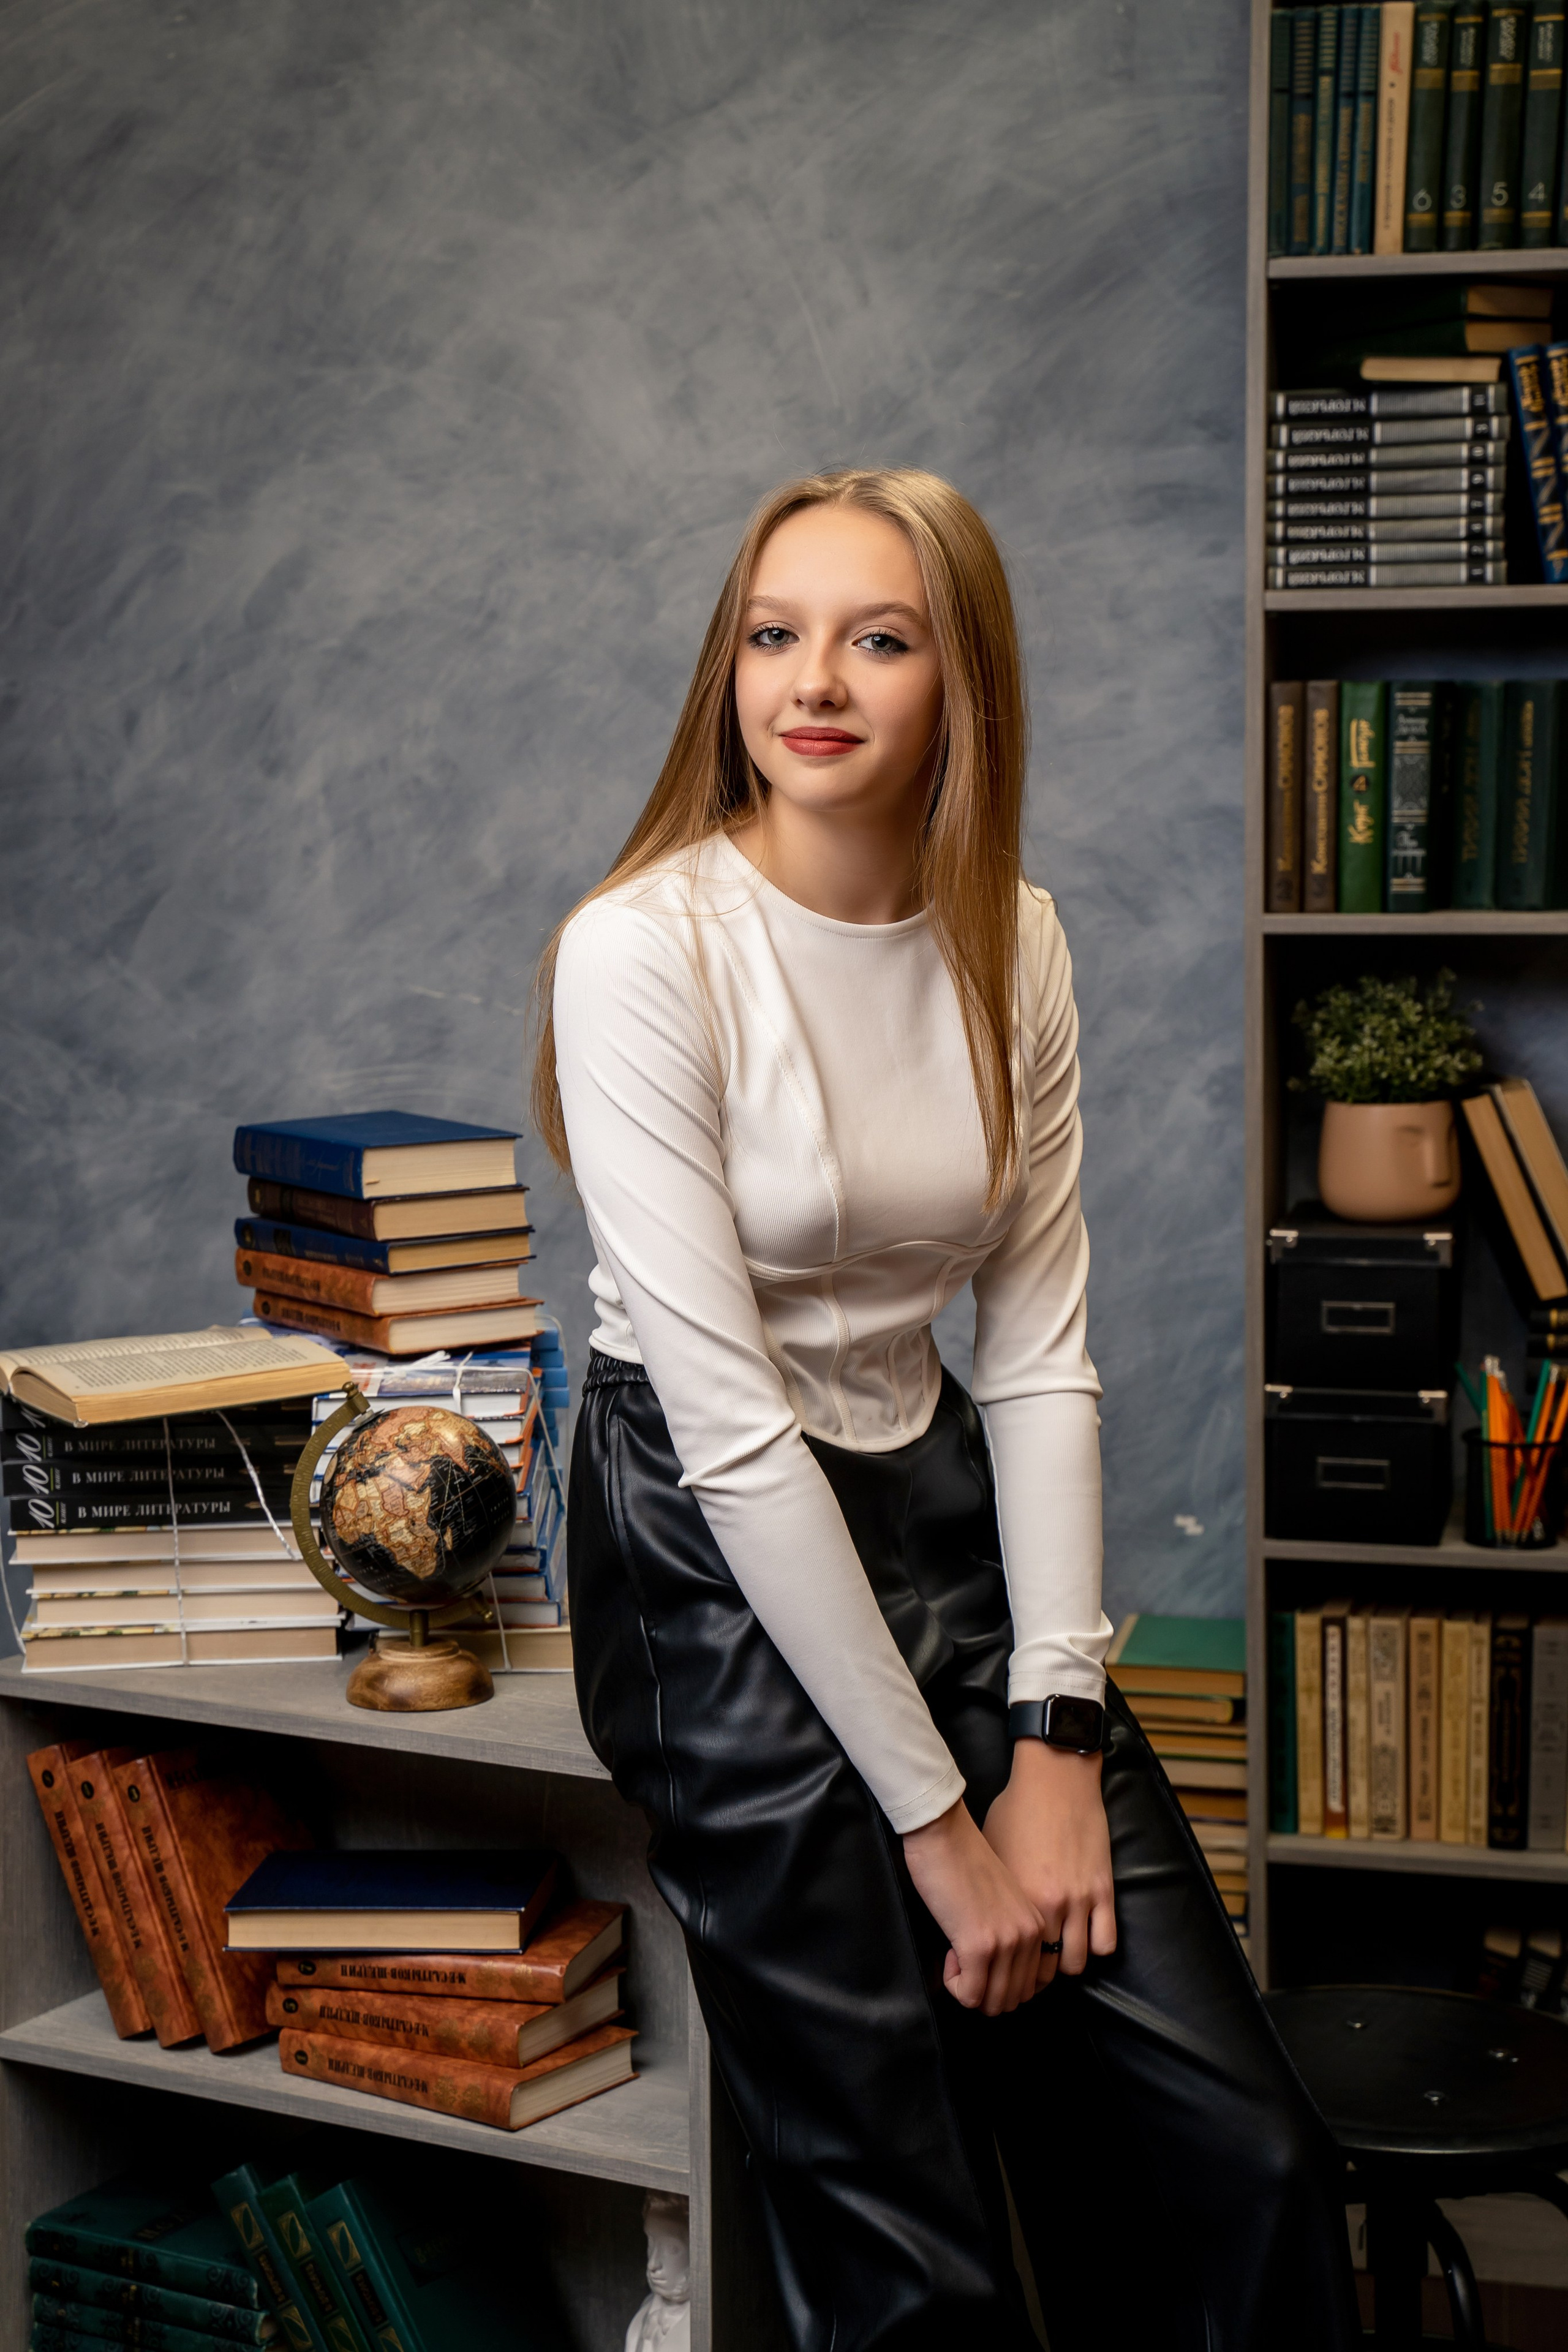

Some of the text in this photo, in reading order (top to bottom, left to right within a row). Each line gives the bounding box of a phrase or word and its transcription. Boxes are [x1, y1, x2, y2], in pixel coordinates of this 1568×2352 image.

[1413, 188, 1432, 211] 6
[1450, 185, 1466, 208] 3
[1491, 182, 1509, 206] 5
[1528, 182, 1547, 203] 4
[15, 1432, 42, 1462] 10
[65, 1441, 74, 1452] В
[78, 1439, 117, 1452] МИРЕ
[22, 1464, 50, 1495] 10
[72, 1472, 81, 1485] В
[86, 1471, 126, 1484] МИРЕ
[28, 1498, 55, 1529] 10
[78, 1506, 87, 1519] В
[92, 1505, 131, 1518] МИРЕ
